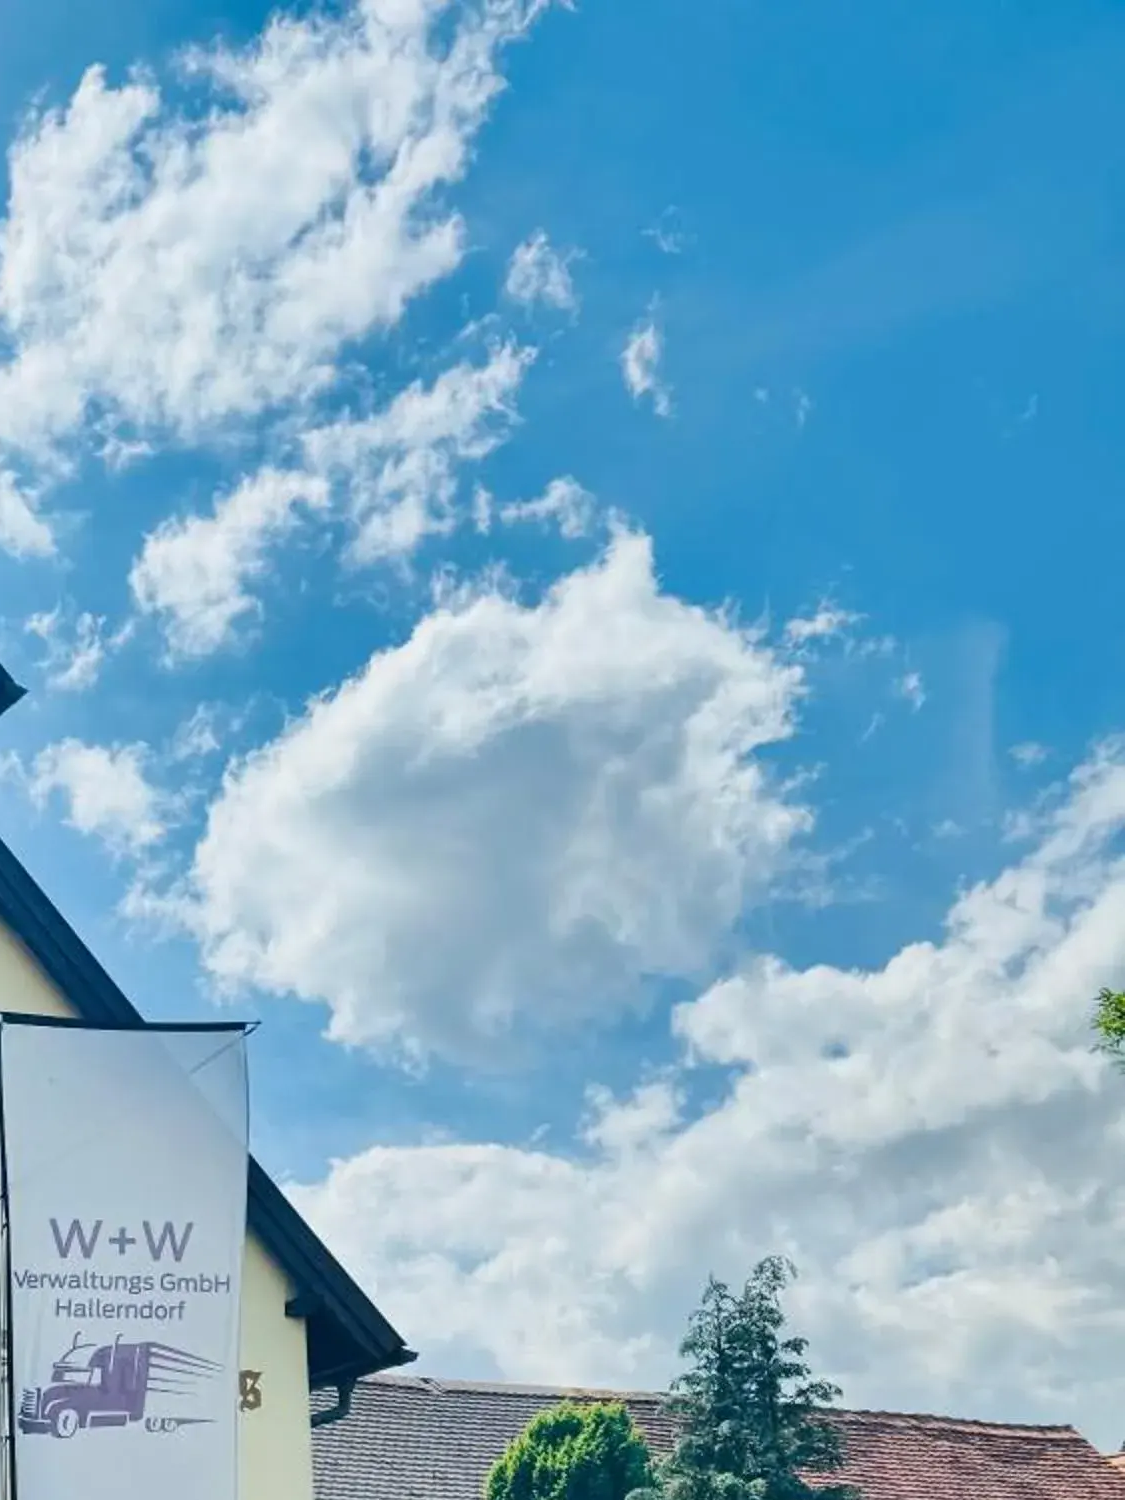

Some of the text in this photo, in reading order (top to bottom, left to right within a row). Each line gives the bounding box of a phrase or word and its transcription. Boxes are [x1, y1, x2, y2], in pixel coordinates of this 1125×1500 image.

[49, 1218, 194, 1262] W+W
[14, 1270, 230, 1294] Verwaltungs GmbH
[55, 1298, 186, 1321] Hallerndorf
